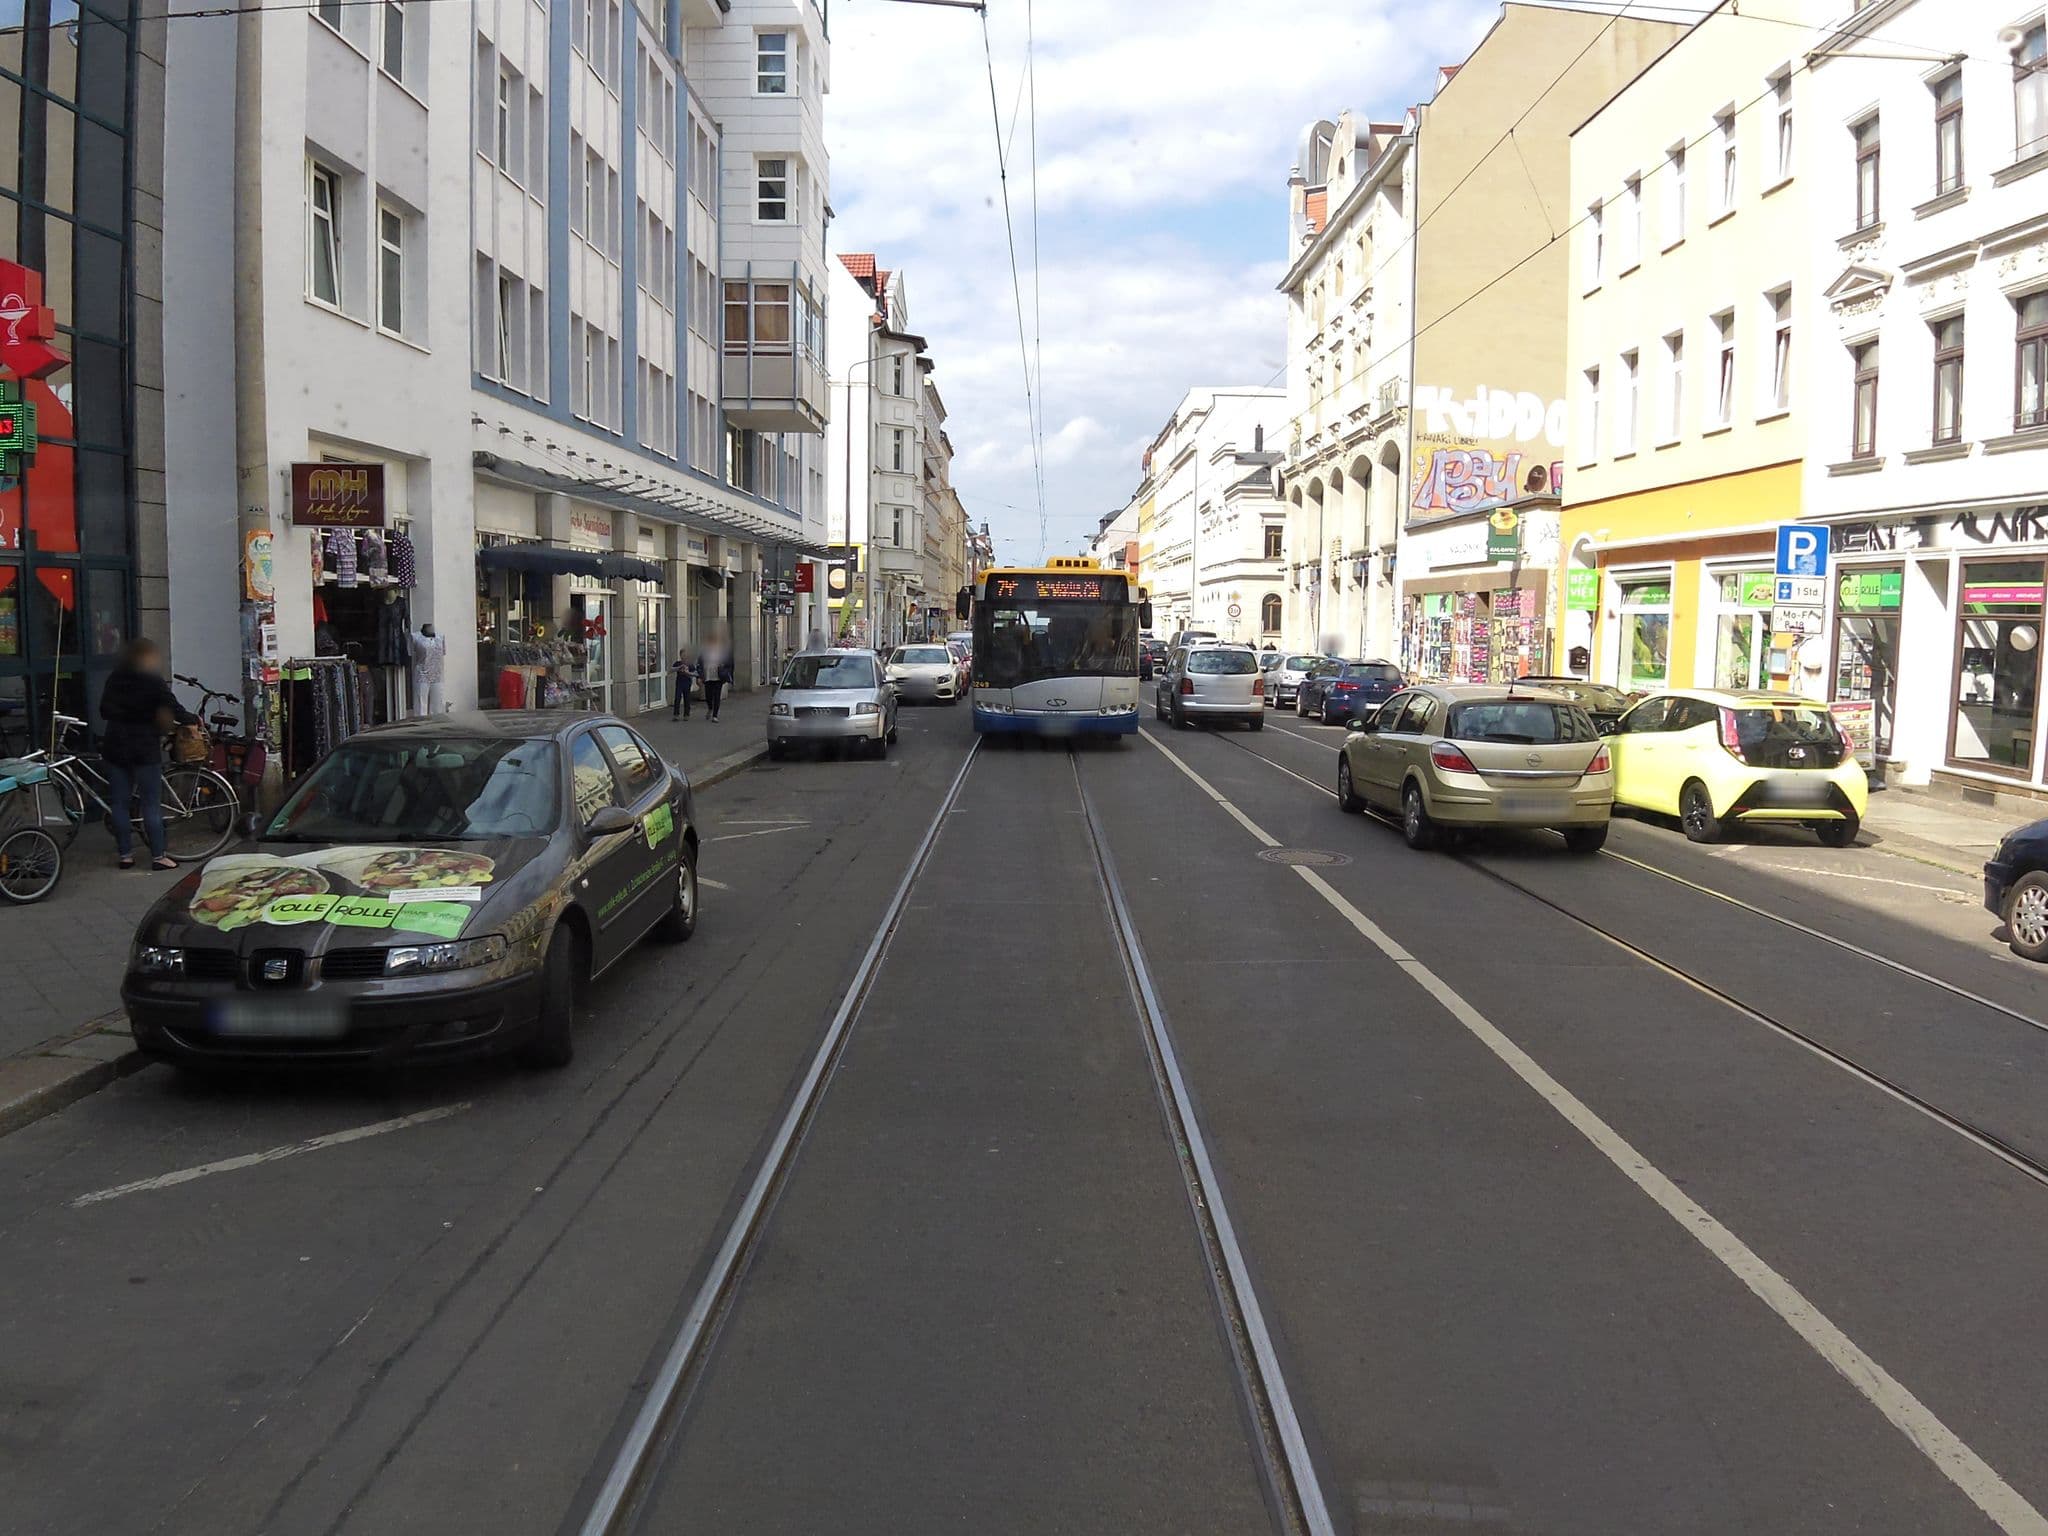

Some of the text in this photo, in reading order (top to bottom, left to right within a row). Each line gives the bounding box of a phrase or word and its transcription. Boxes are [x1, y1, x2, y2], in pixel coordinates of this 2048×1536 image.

[1788, 531, 1817, 570] P
[271, 903, 396, 918] VOLLE ROLLE
